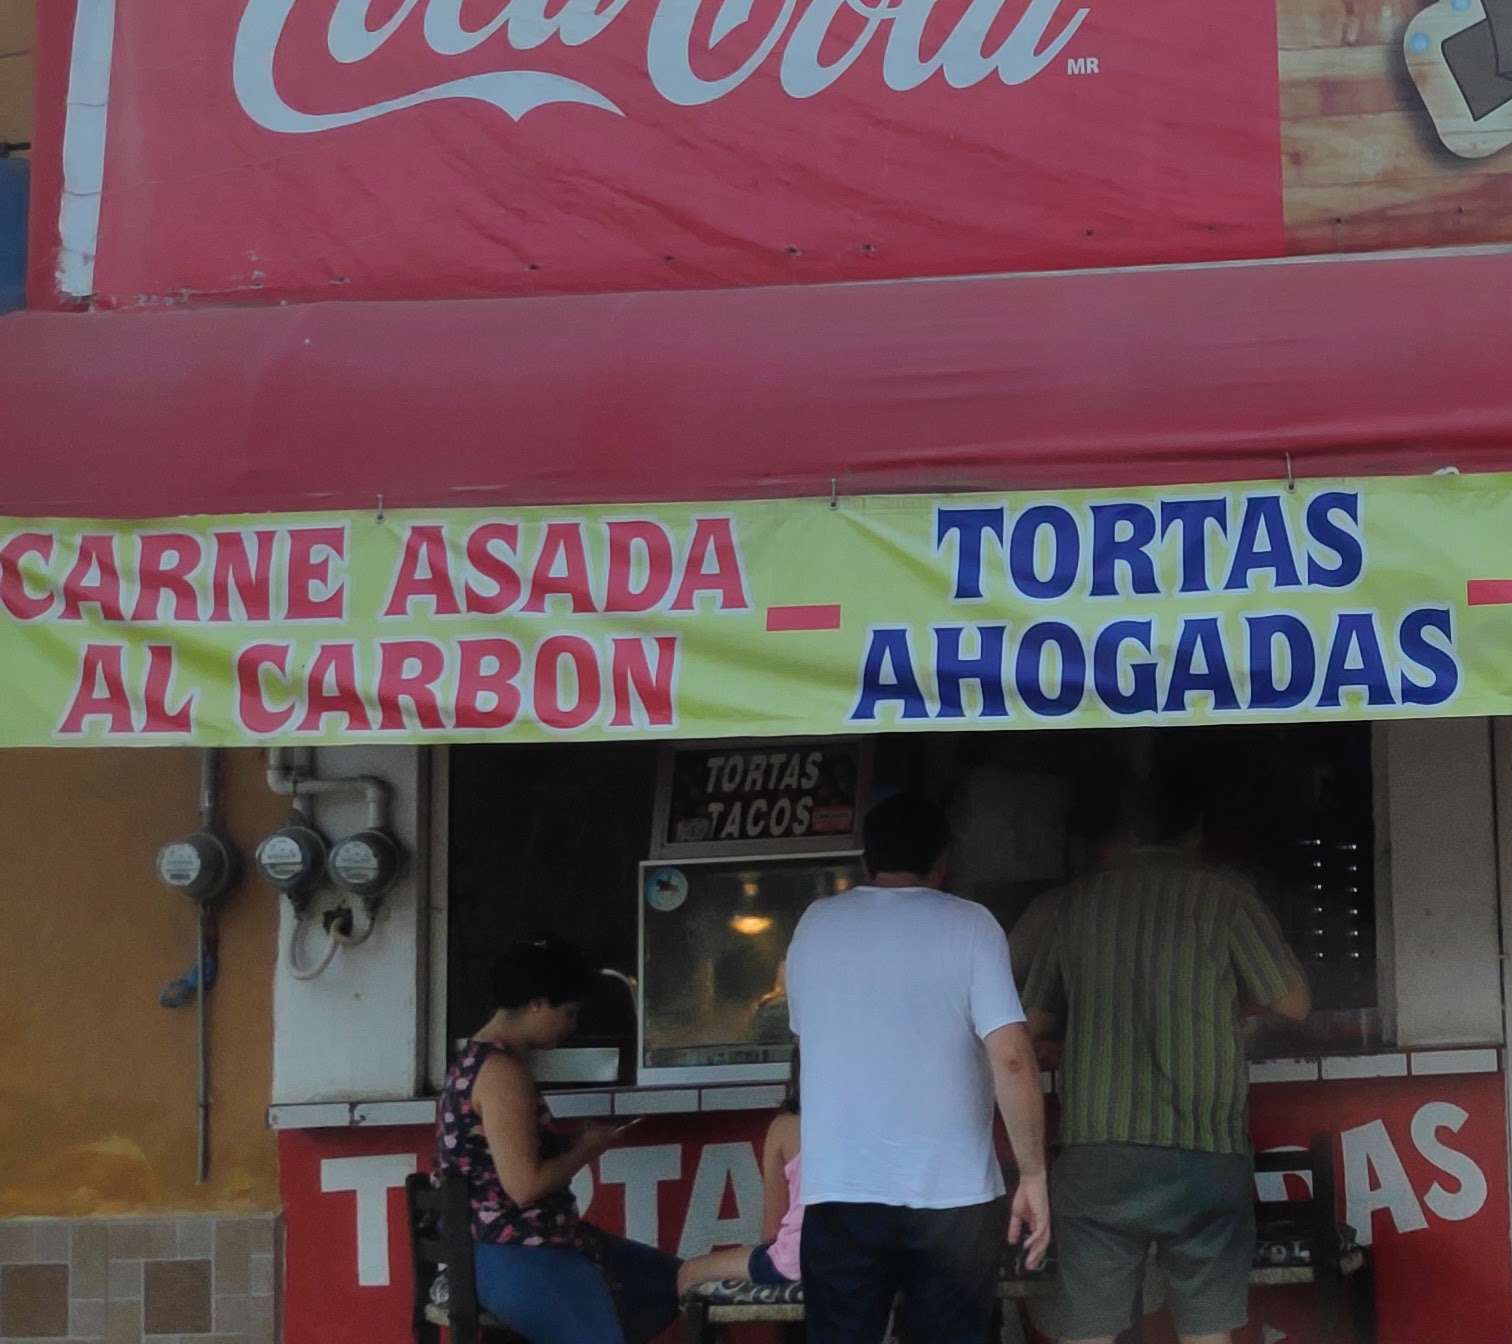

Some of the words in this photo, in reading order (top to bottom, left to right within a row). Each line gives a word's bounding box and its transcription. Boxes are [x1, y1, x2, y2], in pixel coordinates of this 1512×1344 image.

[1066, 57, 1100, 75] MR
[0, 525, 347, 621] CARNE
[383, 517, 749, 617] ASADA
[936, 491, 1363, 599] TORTAS
[58, 644, 193, 734] AL
[236, 636, 680, 734] CARBON
[849, 608, 1459, 720] AHOGADAS
[705, 752, 822, 795] TORTAS
[707, 795, 815, 839] TACOS
